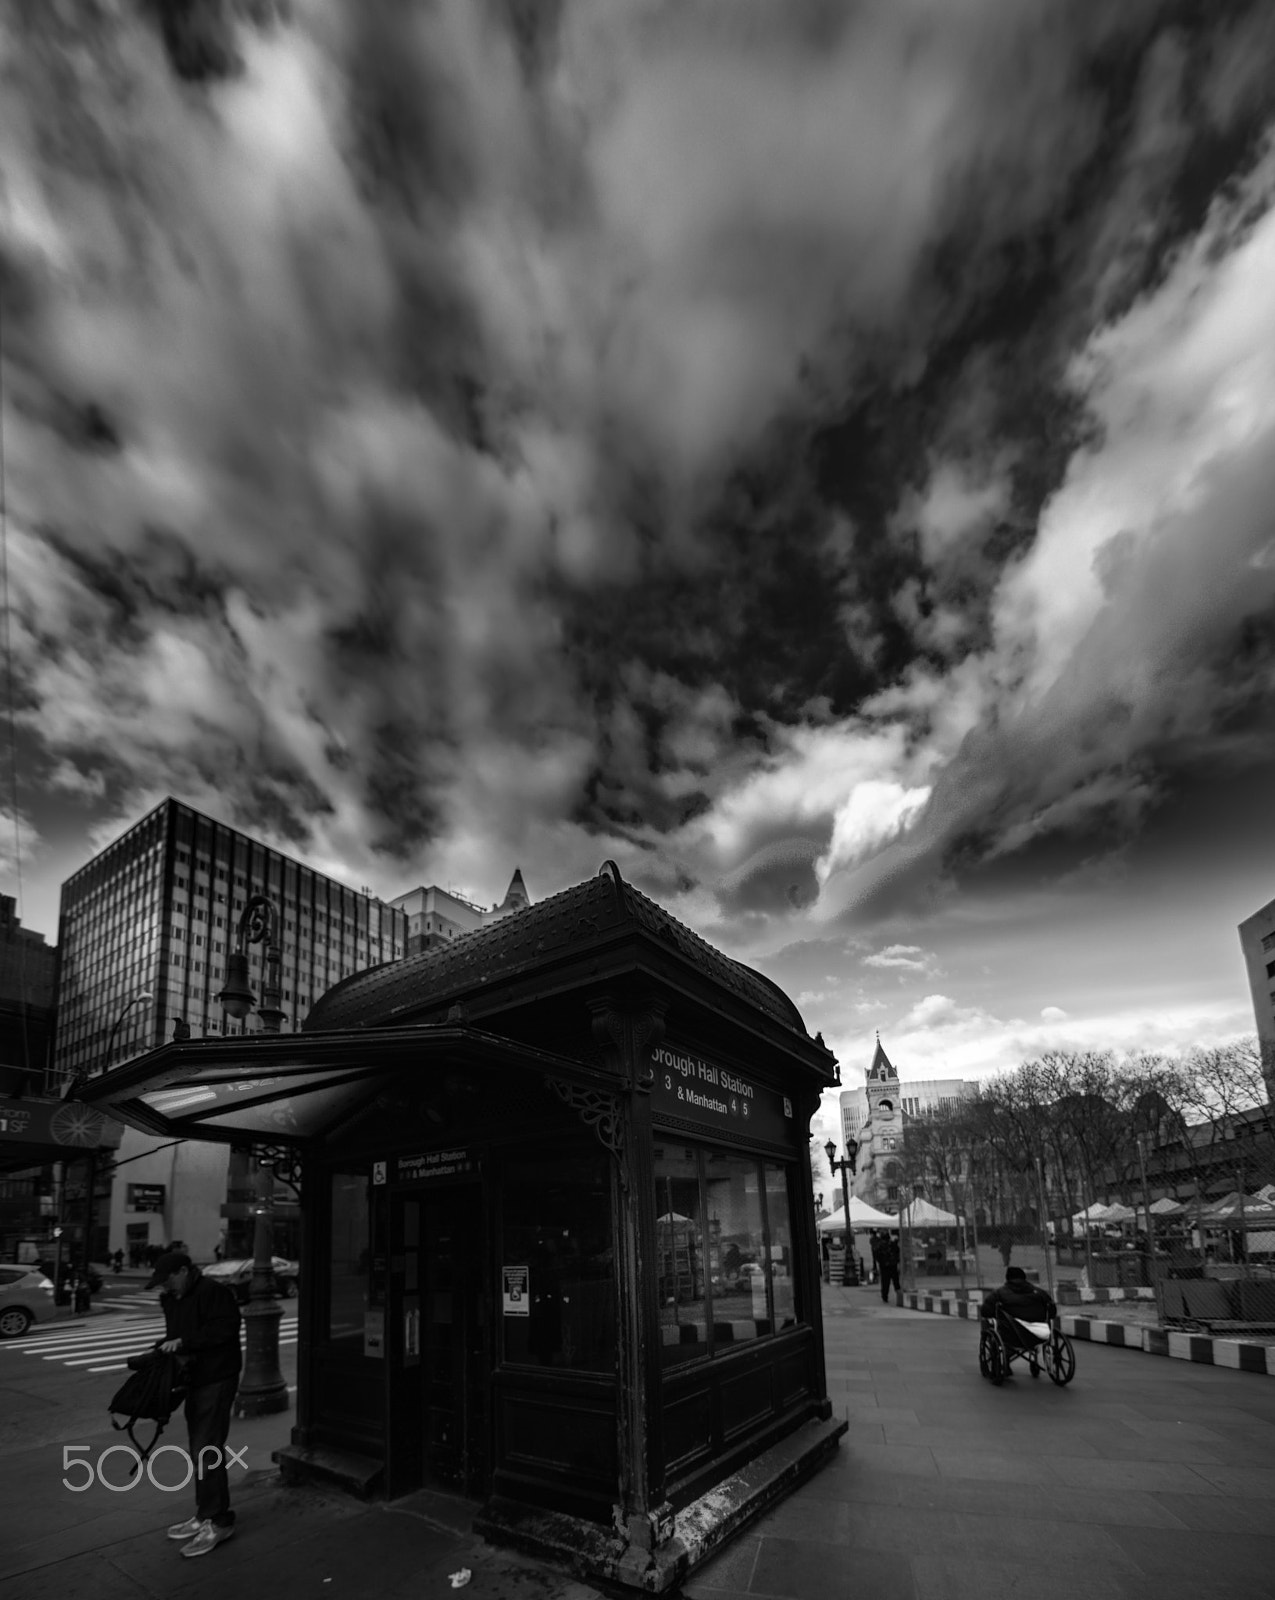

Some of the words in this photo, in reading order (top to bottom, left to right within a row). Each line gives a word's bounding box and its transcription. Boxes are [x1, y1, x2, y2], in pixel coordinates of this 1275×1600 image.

[651, 1048, 695, 1077] orough
[698, 1060, 719, 1086] Hall
[720, 1070, 754, 1098] Station
[664, 1074, 672, 1090] 3
[677, 1086, 685, 1101] &
[686, 1088, 728, 1114] Manhattan
[731, 1099, 737, 1112] 4
[742, 1102, 748, 1115] 5
[10, 1120, 29, 1133] SF
[398, 1157, 425, 1169] Borough
[426, 1154, 440, 1164] Hall
[441, 1152, 466, 1162] Station
[418, 1165, 456, 1177] Manhattan
